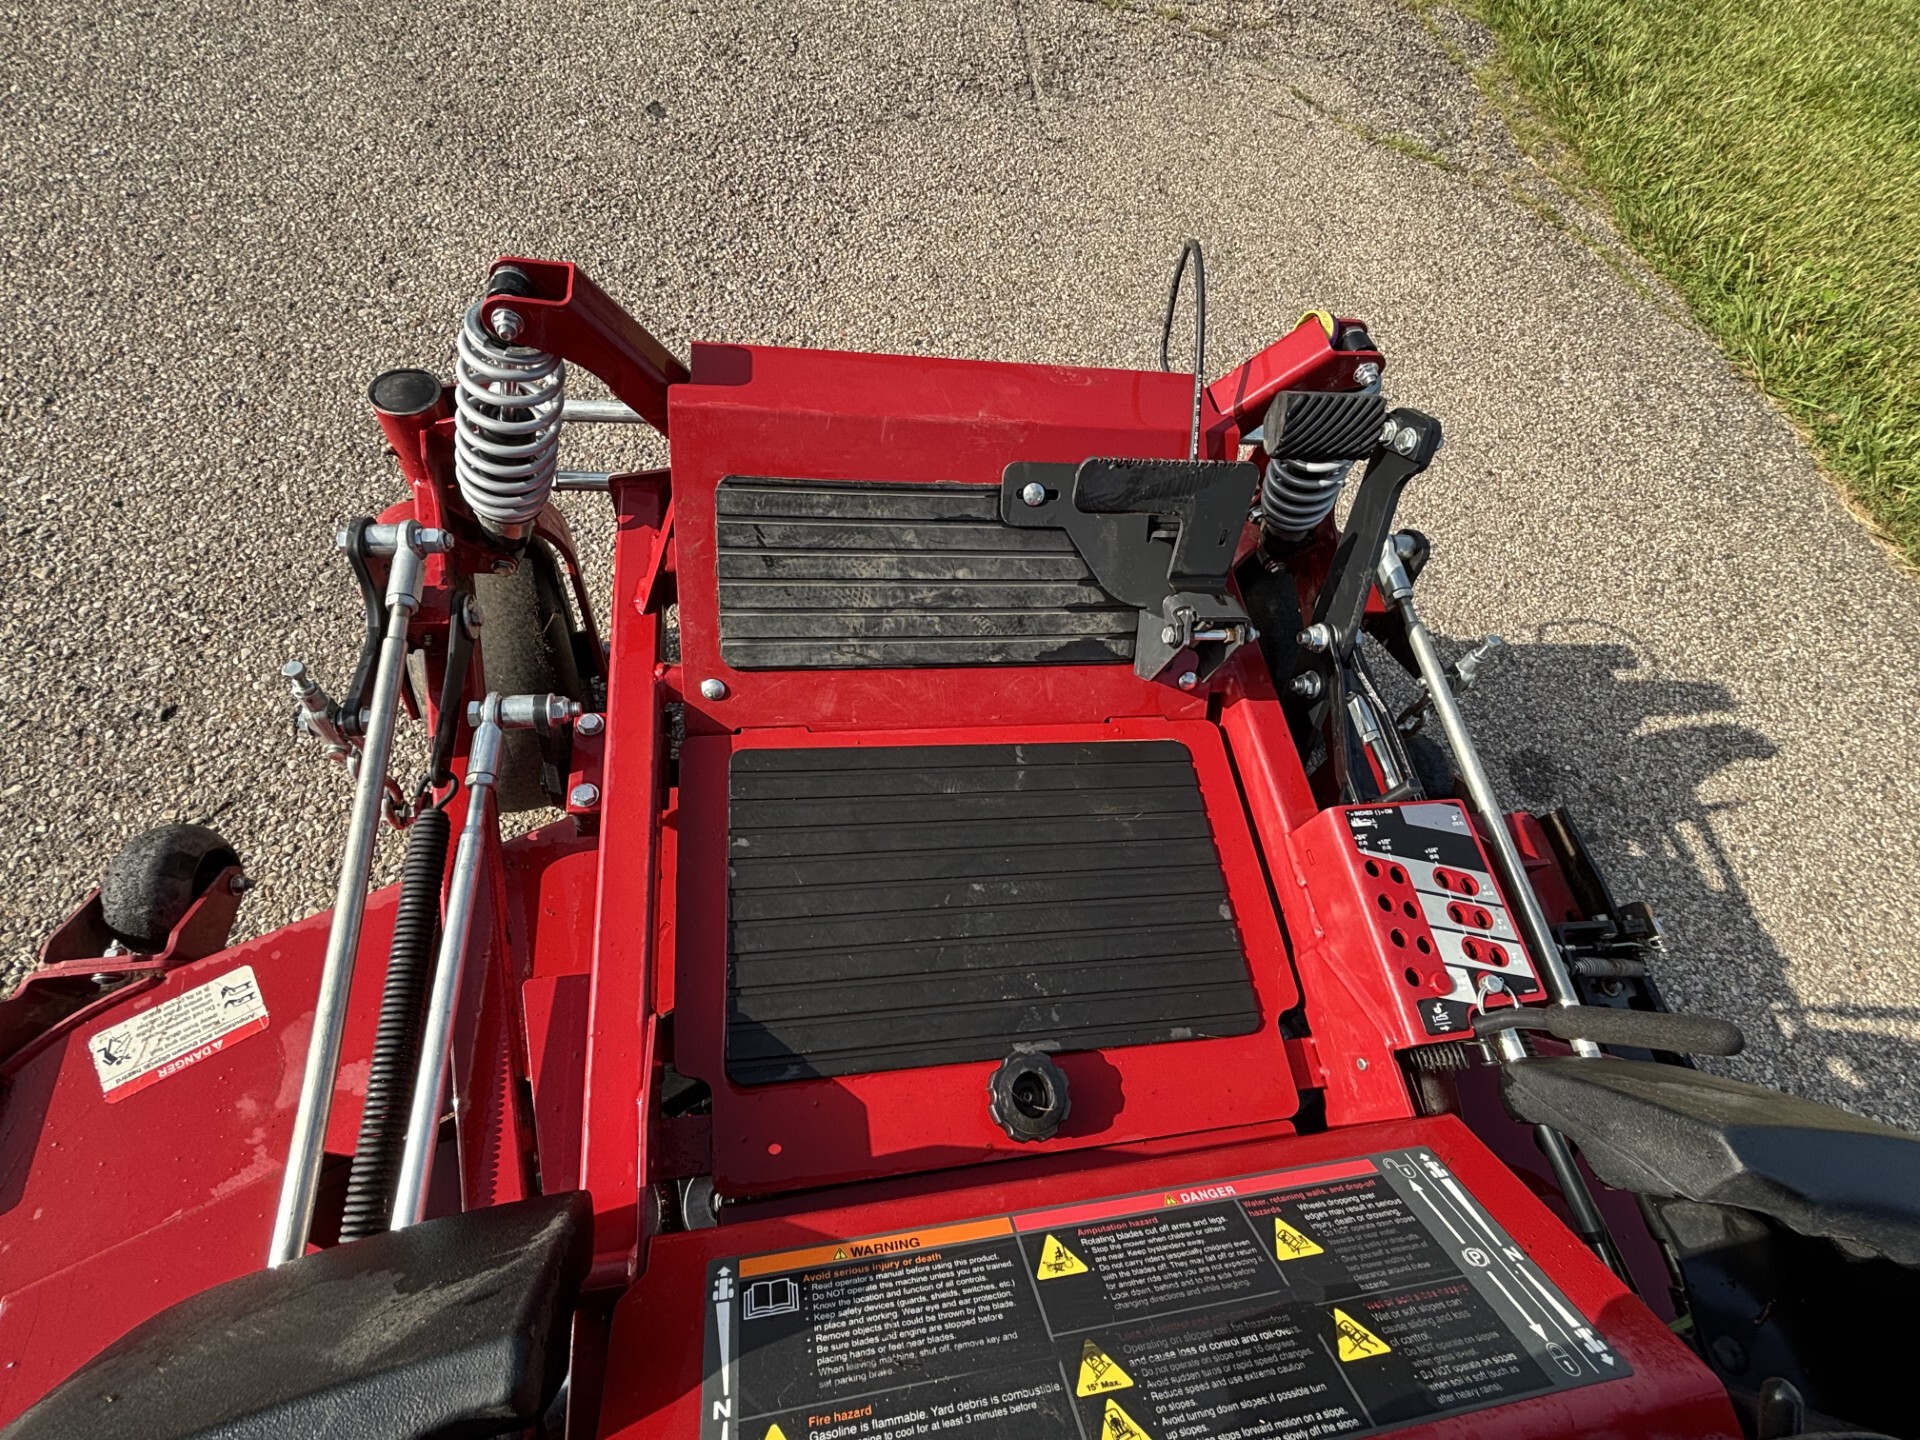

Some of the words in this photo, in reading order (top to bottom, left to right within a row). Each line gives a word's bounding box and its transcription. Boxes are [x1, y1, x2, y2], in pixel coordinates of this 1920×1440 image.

[158, 1046, 212, 1078] DANGER
[1180, 1186, 1236, 1203] DANGER
[1077, 1223, 1127, 1236] Amputation
[1128, 1216, 1158, 1227] hazard
[1080, 1235, 1115, 1246] Rotating
[1115, 1230, 1144, 1240] blades
[1144, 1226, 1158, 1235] cut
[1158, 1224, 1169, 1232] off
[1171, 1222, 1191, 1230] arms
[1192, 1218, 1208, 1227] and
[1167, 1231, 1195, 1240] children
[849, 1237, 920, 1258] WARNING
[1502, 1246, 1524, 1262] N
[803, 1270, 831, 1282] Avoid
[902, 1258, 912, 1266] or
[915, 1253, 941, 1263] death
[811, 1281, 833, 1290] Read
[875, 1268, 904, 1280] manual
[905, 1265, 930, 1275] before
[931, 1262, 952, 1270] using
[969, 1253, 998, 1265] product.
[812, 1293, 824, 1301] Do
[826, 1288, 844, 1298] NOT
[879, 1281, 893, 1289] this
[895, 1275, 928, 1286] machine
[929, 1271, 955, 1280] unless
[956, 1268, 970, 1277] you
[813, 1302, 836, 1311] Know
[853, 1293, 884, 1303] location
[886, 1288, 901, 1298] and
[903, 1284, 934, 1294] function
[935, 1281, 943, 1289] of
[945, 1279, 954, 1287] all
[813, 1312, 835, 1321] Keep
[838, 1307, 862, 1317] safety
[863, 1301, 895, 1312] devices
[815, 1330, 850, 1342] Remove
[852, 1324, 882, 1336] objects
[901, 1315, 924, 1326] could
[925, 1314, 936, 1322] be
[937, 1309, 965, 1320] thrown
[966, 1307, 976, 1315] by
[823, 1320, 846, 1331] place
[848, 1315, 864, 1326] and
[901, 1306, 923, 1315] Wear
[925, 1303, 939, 1312] eye
[941, 1299, 957, 1308] and
[958, 1298, 971, 1306] ear
[816, 1345, 828, 1353] Be
[830, 1342, 849, 1351] sure
[851, 1335, 879, 1347] blades
[899, 1327, 927, 1338] engine
[929, 1324, 942, 1332] are
[944, 1317, 976, 1329] stopped
[977, 1313, 1003, 1323] before
[816, 1353, 847, 1367] placing
[849, 1348, 876, 1358] hands
[888, 1342, 904, 1351] feet
[926, 1333, 956, 1344] blades.
[1129, 1355, 1146, 1366] and
[1148, 1350, 1176, 1362] cause
[1177, 1346, 1197, 1355] loss
[1198, 1343, 1207, 1352] of
[1208, 1338, 1240, 1350] control
[1241, 1334, 1258, 1344] and
[1086, 1382, 1099, 1392] 15°
[1101, 1380, 1121, 1389] Max.
[713, 1398, 732, 1421] N
[808, 1415, 831, 1427] Fire
[833, 1404, 872, 1422] hazard
[809, 1425, 857, 1440] Gasoline
[860, 1422, 869, 1432] is
[871, 1410, 928, 1429] flammable.
[930, 1403, 954, 1416] Yard
[956, 1398, 988, 1412] debris
[990, 1395, 999, 1404] is
[1001, 1383, 1063, 1402] combustible.
[883, 1432, 893, 1440] to
[895, 1425, 914, 1438] cool
[916, 1424, 928, 1433] for
[931, 1421, 940, 1430] at
[941, 1416, 964, 1428] least
[965, 1413, 971, 1423] 3
[973, 1407, 1008, 1421] minutes
[1009, 1401, 1037, 1414] before
[1217, 1430, 1241, 1440] stops
[1241, 1422, 1274, 1436] forward
[1274, 1416, 1303, 1429] motion
[1303, 1414, 1315, 1423] on
[1315, 1412, 1322, 1420] a
